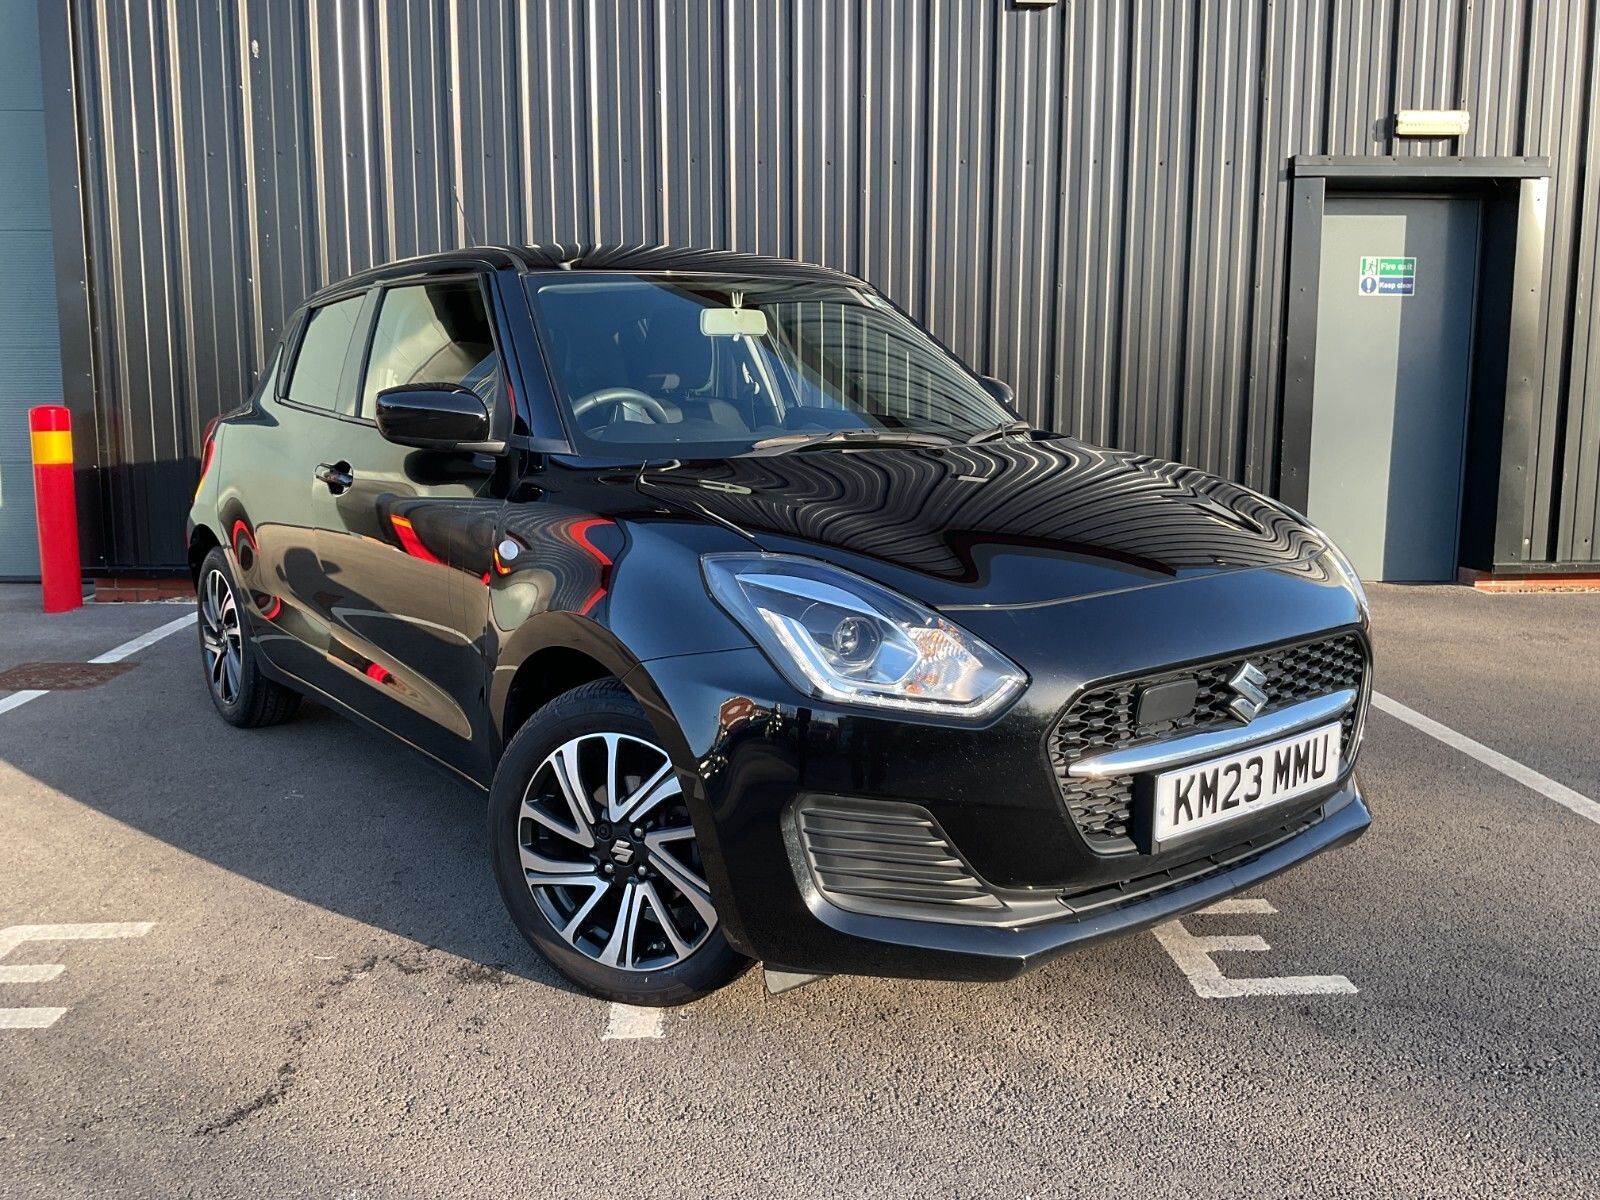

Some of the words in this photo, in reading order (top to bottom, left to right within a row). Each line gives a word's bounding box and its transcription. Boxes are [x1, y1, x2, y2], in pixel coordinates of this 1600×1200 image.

[1380, 263, 1396, 271] Fire
[1397, 263, 1412, 271] exit
[1380, 282, 1396, 290] Keep
[1173, 755, 1264, 826] KM23
[1272, 734, 1329, 795] MMU
